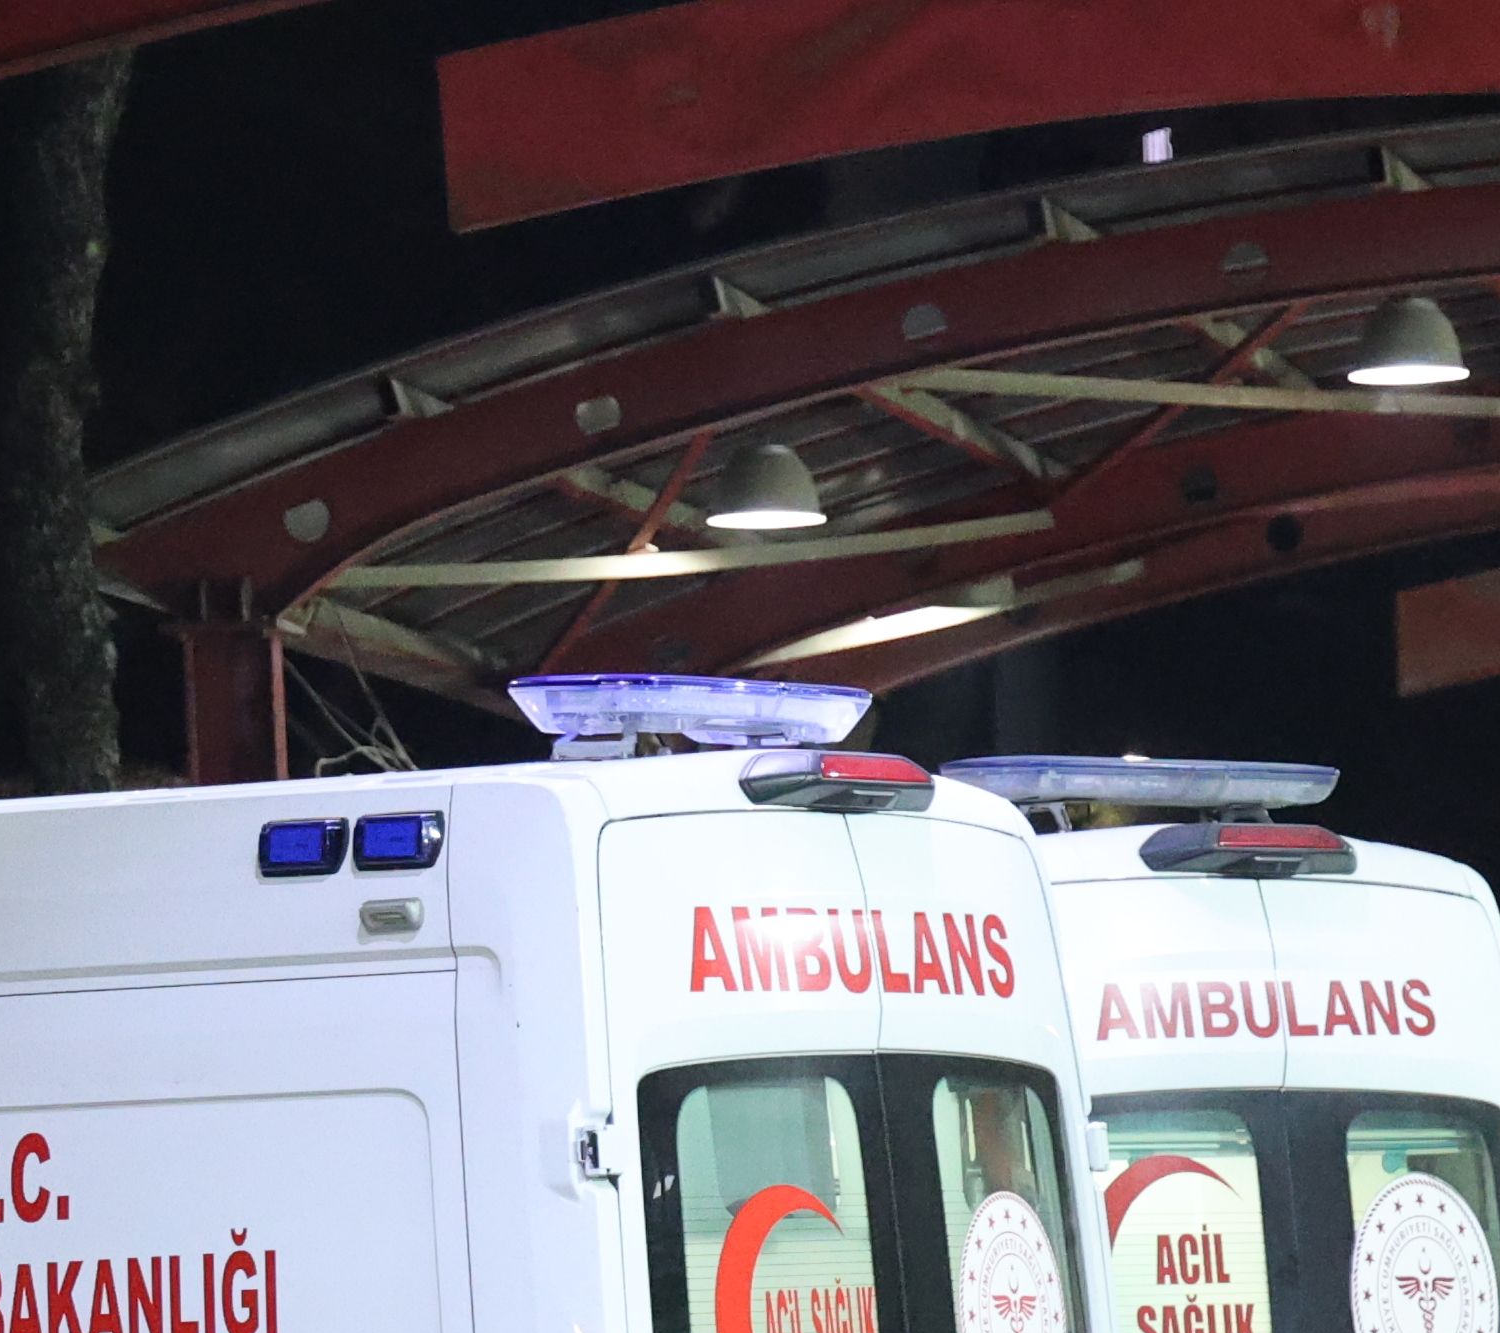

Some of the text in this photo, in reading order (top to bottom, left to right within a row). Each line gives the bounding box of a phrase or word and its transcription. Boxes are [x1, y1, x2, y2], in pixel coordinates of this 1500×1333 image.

[690, 906, 1015, 998] AMBULANS
[1096, 979, 1436, 1041] AMBULANS
[1157, 1223, 1230, 1285] ACİL
